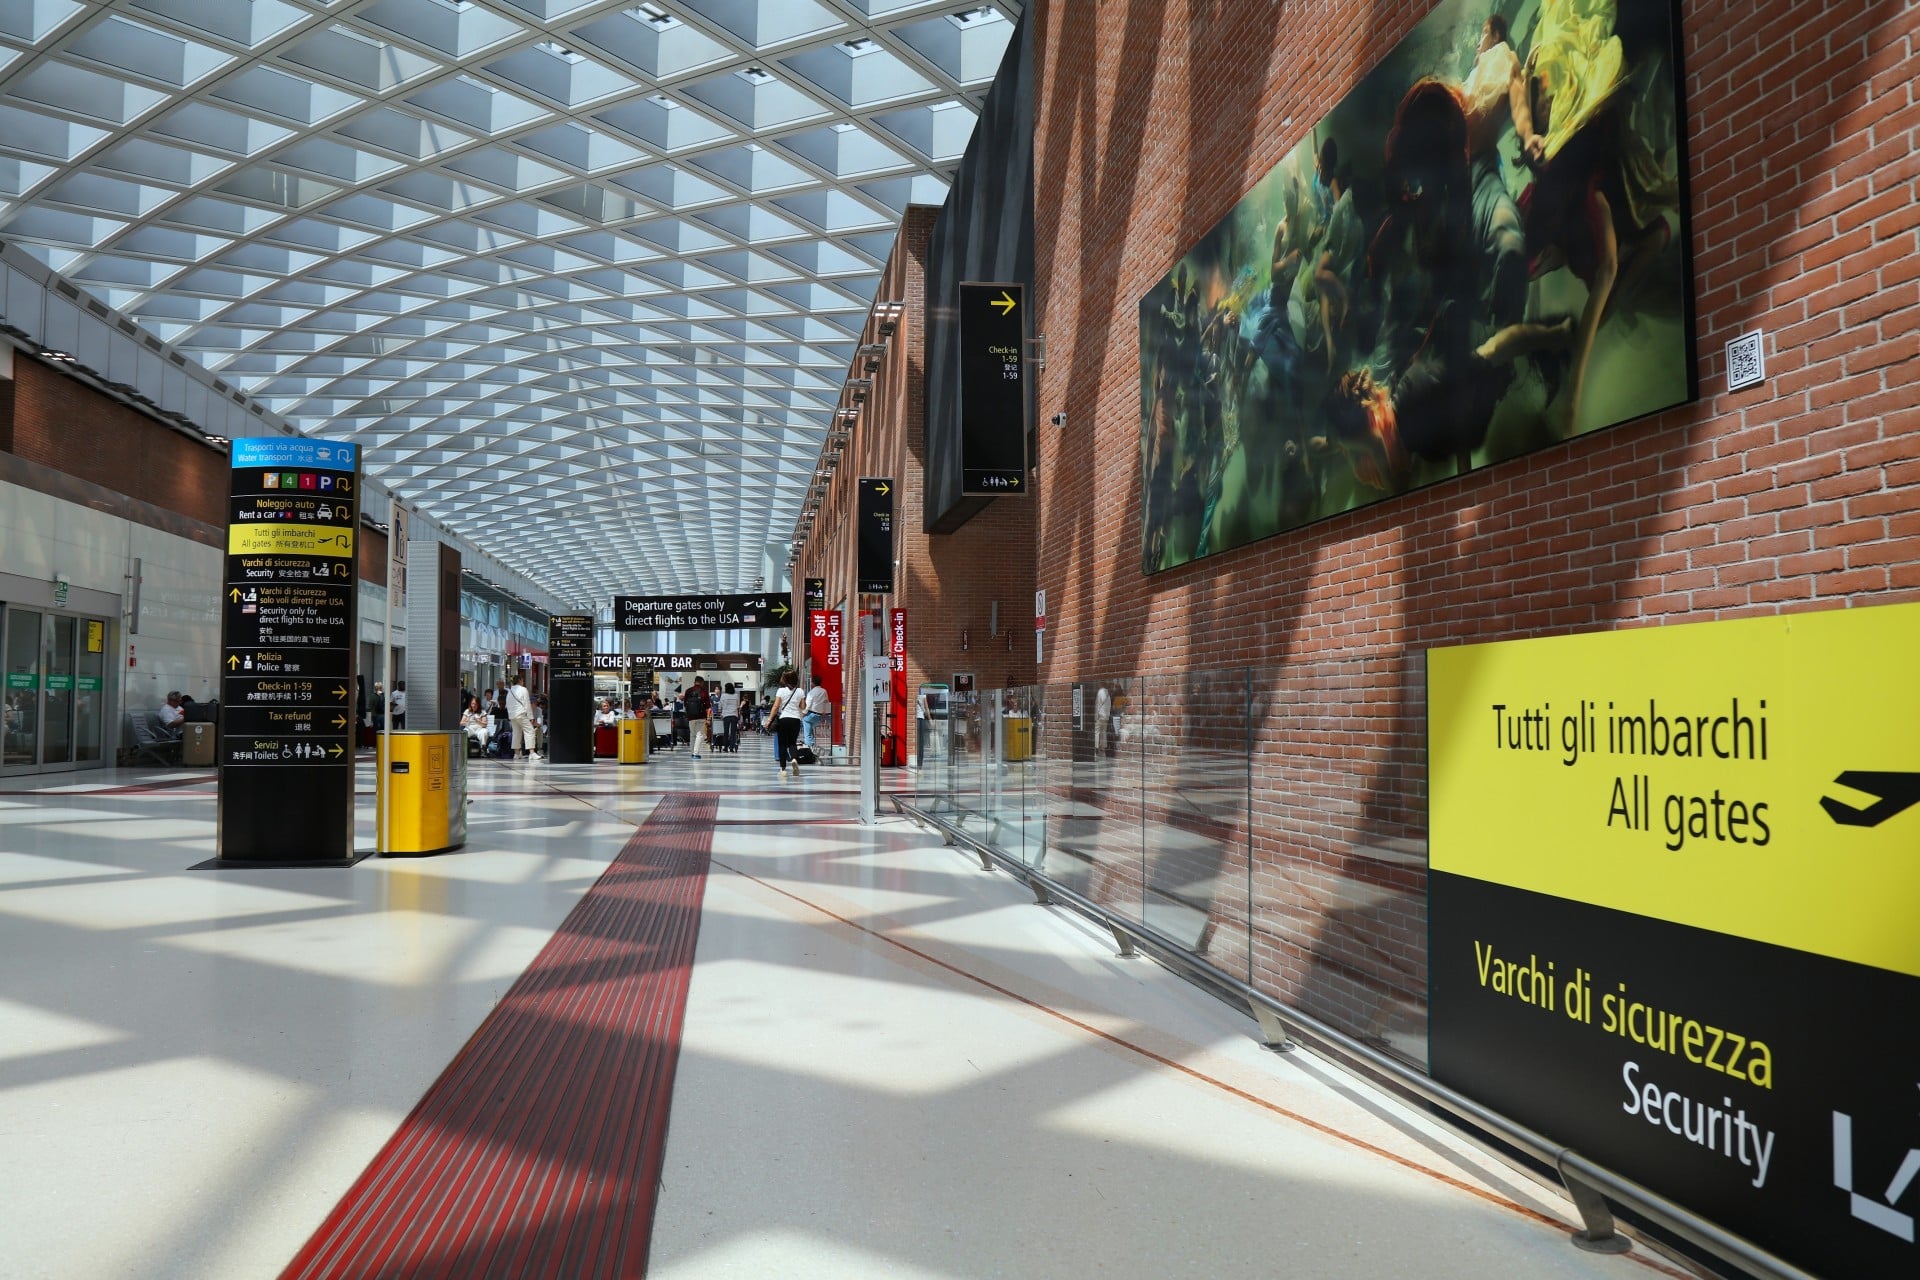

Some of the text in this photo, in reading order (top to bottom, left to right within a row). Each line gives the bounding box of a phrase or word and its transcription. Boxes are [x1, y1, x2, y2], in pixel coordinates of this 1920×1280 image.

[245, 444, 274, 452] Trasporti
[259, 454, 292, 462] transport
[286, 477, 292, 485] 4
[305, 478, 310, 486] 1
[320, 477, 331, 489] P
[256, 499, 292, 509] Noleggio
[239, 511, 255, 519] Rent
[272, 528, 280, 538] gli
[282, 529, 315, 538] imbarchi
[252, 541, 271, 549] gates
[242, 559, 263, 567] Varchi
[274, 559, 310, 568] sicurezza
[246, 569, 274, 579] Security
[260, 587, 282, 595] Varchi
[293, 588, 327, 596] sicurezza
[625, 598, 725, 614] Departure gates only
[260, 607, 288, 616] Security
[289, 607, 305, 616] only
[259, 616, 279, 624] direct
[281, 616, 304, 626] flights
[625, 614, 740, 627] direct flights to the USA
[814, 615, 826, 637] Self
[894, 612, 904, 653] Check-in
[828, 615, 839, 665] Check-in
[257, 652, 282, 661] Polizia
[594, 656, 630, 668] ITCHEN
[671, 657, 692, 668] BAR
[257, 663, 279, 672] Police
[257, 682, 312, 690] Check-in 1-59
[268, 712, 312, 720] Tax refund
[1492, 698, 1768, 766] Tutti gli imbarchi
[254, 741, 279, 749] Servizi
[254, 751, 279, 759] Toilets
[1607, 775, 1771, 852] All gates
[1474, 940, 1772, 1090] Varchi di sicurezza
[1622, 1060, 1775, 1189] Security
